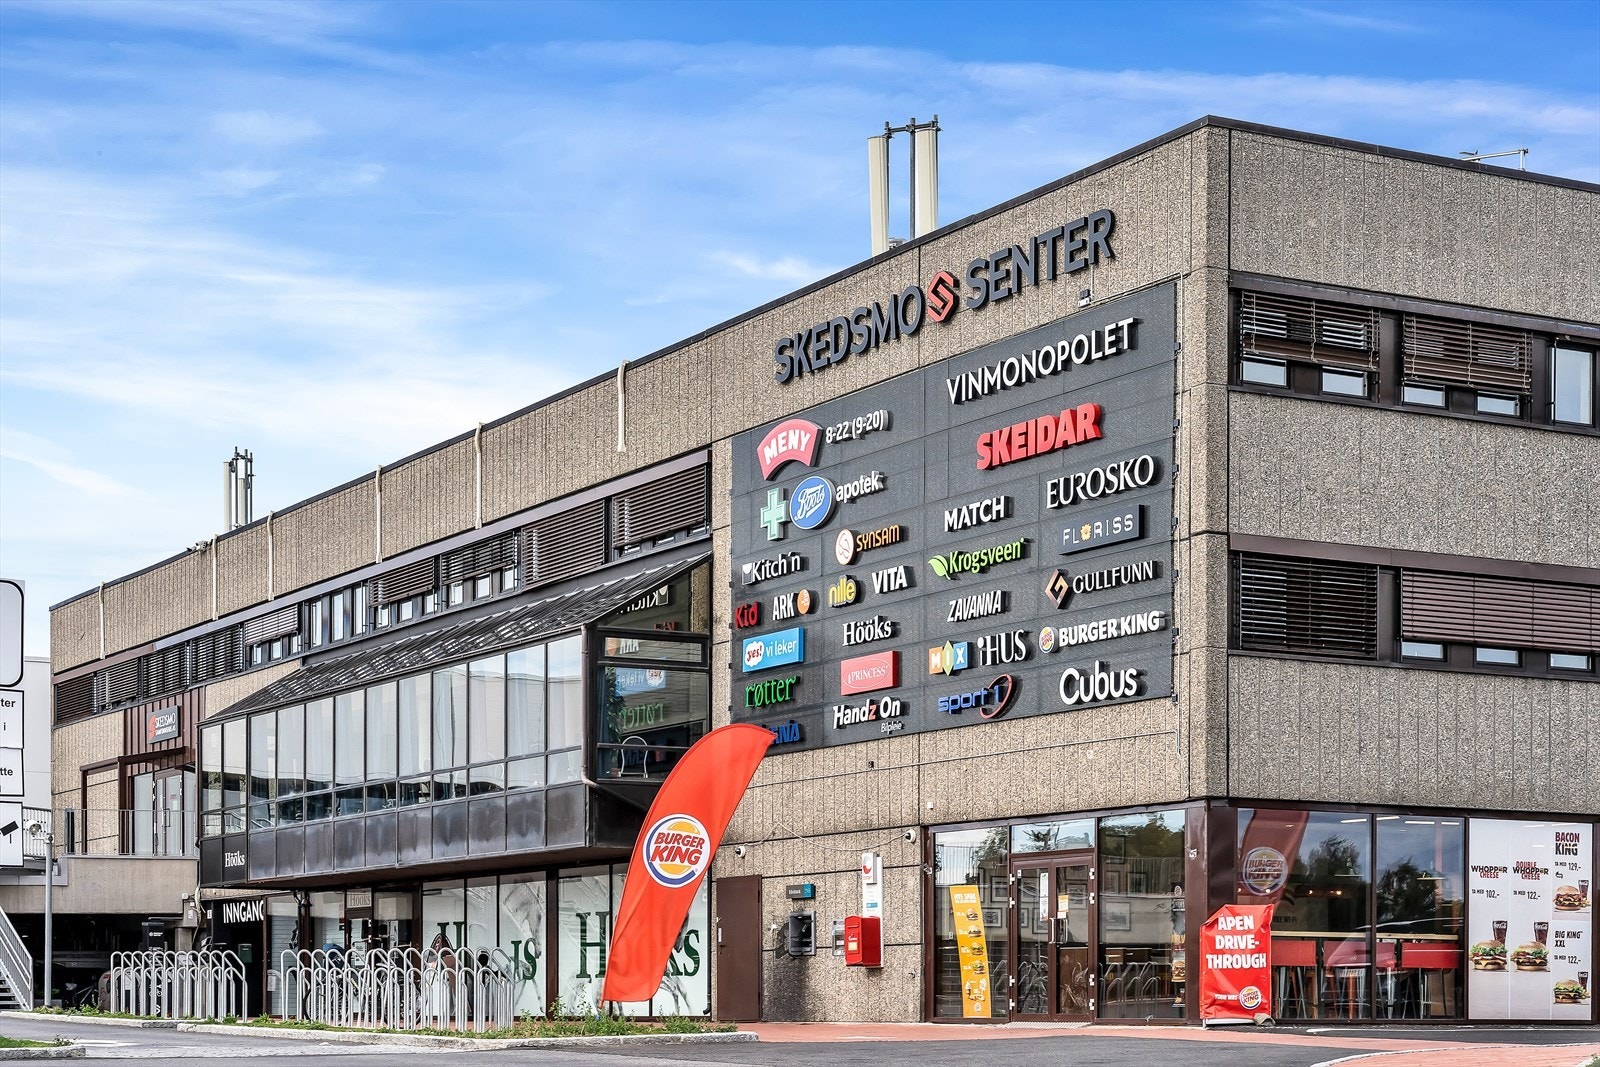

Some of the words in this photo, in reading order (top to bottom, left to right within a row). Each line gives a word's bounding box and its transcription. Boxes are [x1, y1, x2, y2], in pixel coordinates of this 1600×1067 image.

[774, 285, 924, 383] SKEDSMO
[965, 208, 1116, 311] SENTER
[946, 317, 1137, 405] VINMONOPOLET
[763, 429, 811, 466] MENY
[825, 421, 849, 443] 8-22
[851, 409, 886, 439] (9-20)
[977, 402, 1101, 470] SKEIDAR
[794, 483, 825, 521] Boots
[836, 470, 882, 503] apotek
[1046, 454, 1155, 510] EUROSKO
[944, 495, 1006, 532] MATCH
[856, 524, 900, 552] SYNSAM
[949, 541, 1022, 574] Krogsveen
[829, 575, 857, 608] nille
[871, 565, 908, 594] VITA
[1073, 560, 1153, 594] GULLFUNN
[772, 592, 796, 621] ARK
[947, 590, 1002, 622] ZAVANNA
[842, 615, 892, 647] Hööks
[1059, 618, 1117, 648] BURGER
[1118, 610, 1162, 634] KING
[774, 638, 797, 656] leker
[977, 629, 1026, 666] iHUS
[1060, 660, 1138, 705] Cubus
[879, 696, 901, 719] On
[654, 832, 705, 849] BURGER
[1555, 832, 1580, 843] BACON
[1555, 843, 1579, 856] KING
[224, 851, 245, 867] Hööks
[650, 845, 703, 866] KING
[1568, 862, 1581, 872] 129,-
[1486, 889, 1500, 899] 102,-
[1527, 891, 1541, 900] 122,-
[1215, 935, 1259, 950] DRIVE-
[1554, 930, 1565, 939] BIG
[1554, 940, 1566, 948] XXL
[1206, 953, 1266, 970] THROUGH
[1568, 955, 1581, 965] 122,-
